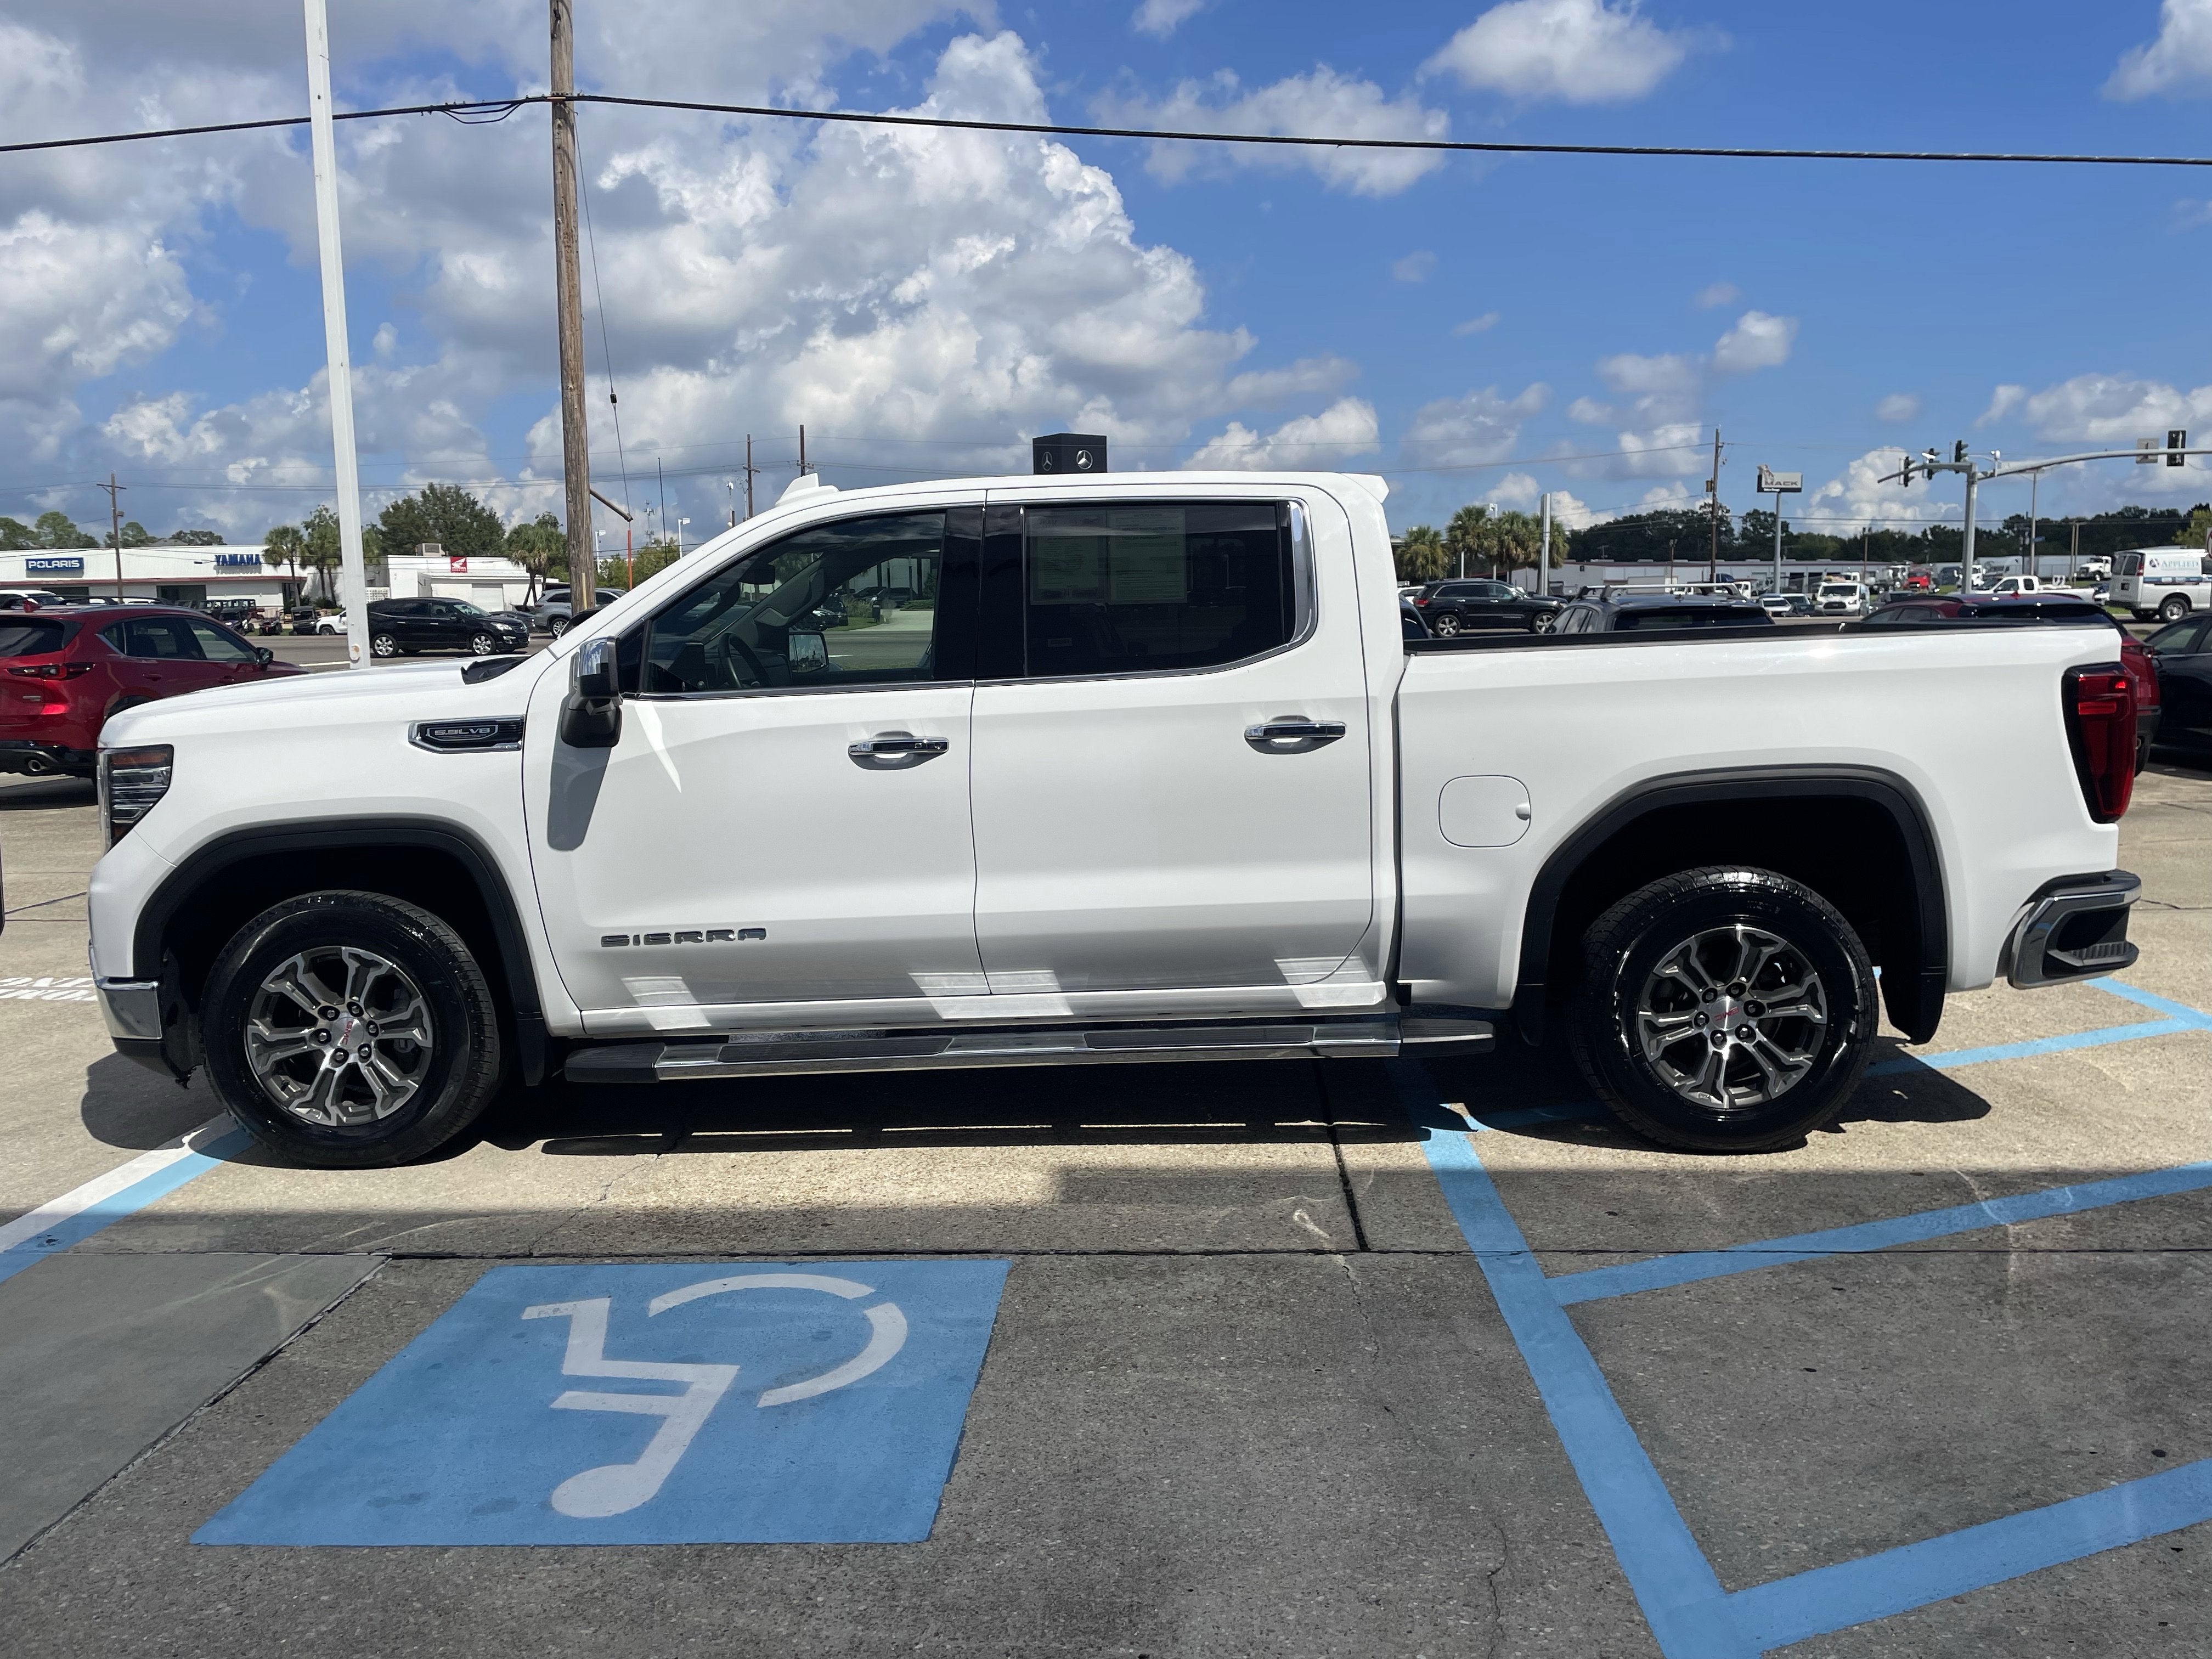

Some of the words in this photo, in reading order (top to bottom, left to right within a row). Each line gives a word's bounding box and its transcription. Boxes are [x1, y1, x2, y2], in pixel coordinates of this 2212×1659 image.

[28, 560, 80, 568] POLARIS
[215, 554, 262, 566] YAMAHA
[601, 928, 767, 947] SIERRA
[1714, 1006, 1739, 1022] GMC
[342, 1020, 353, 1045] GMC
